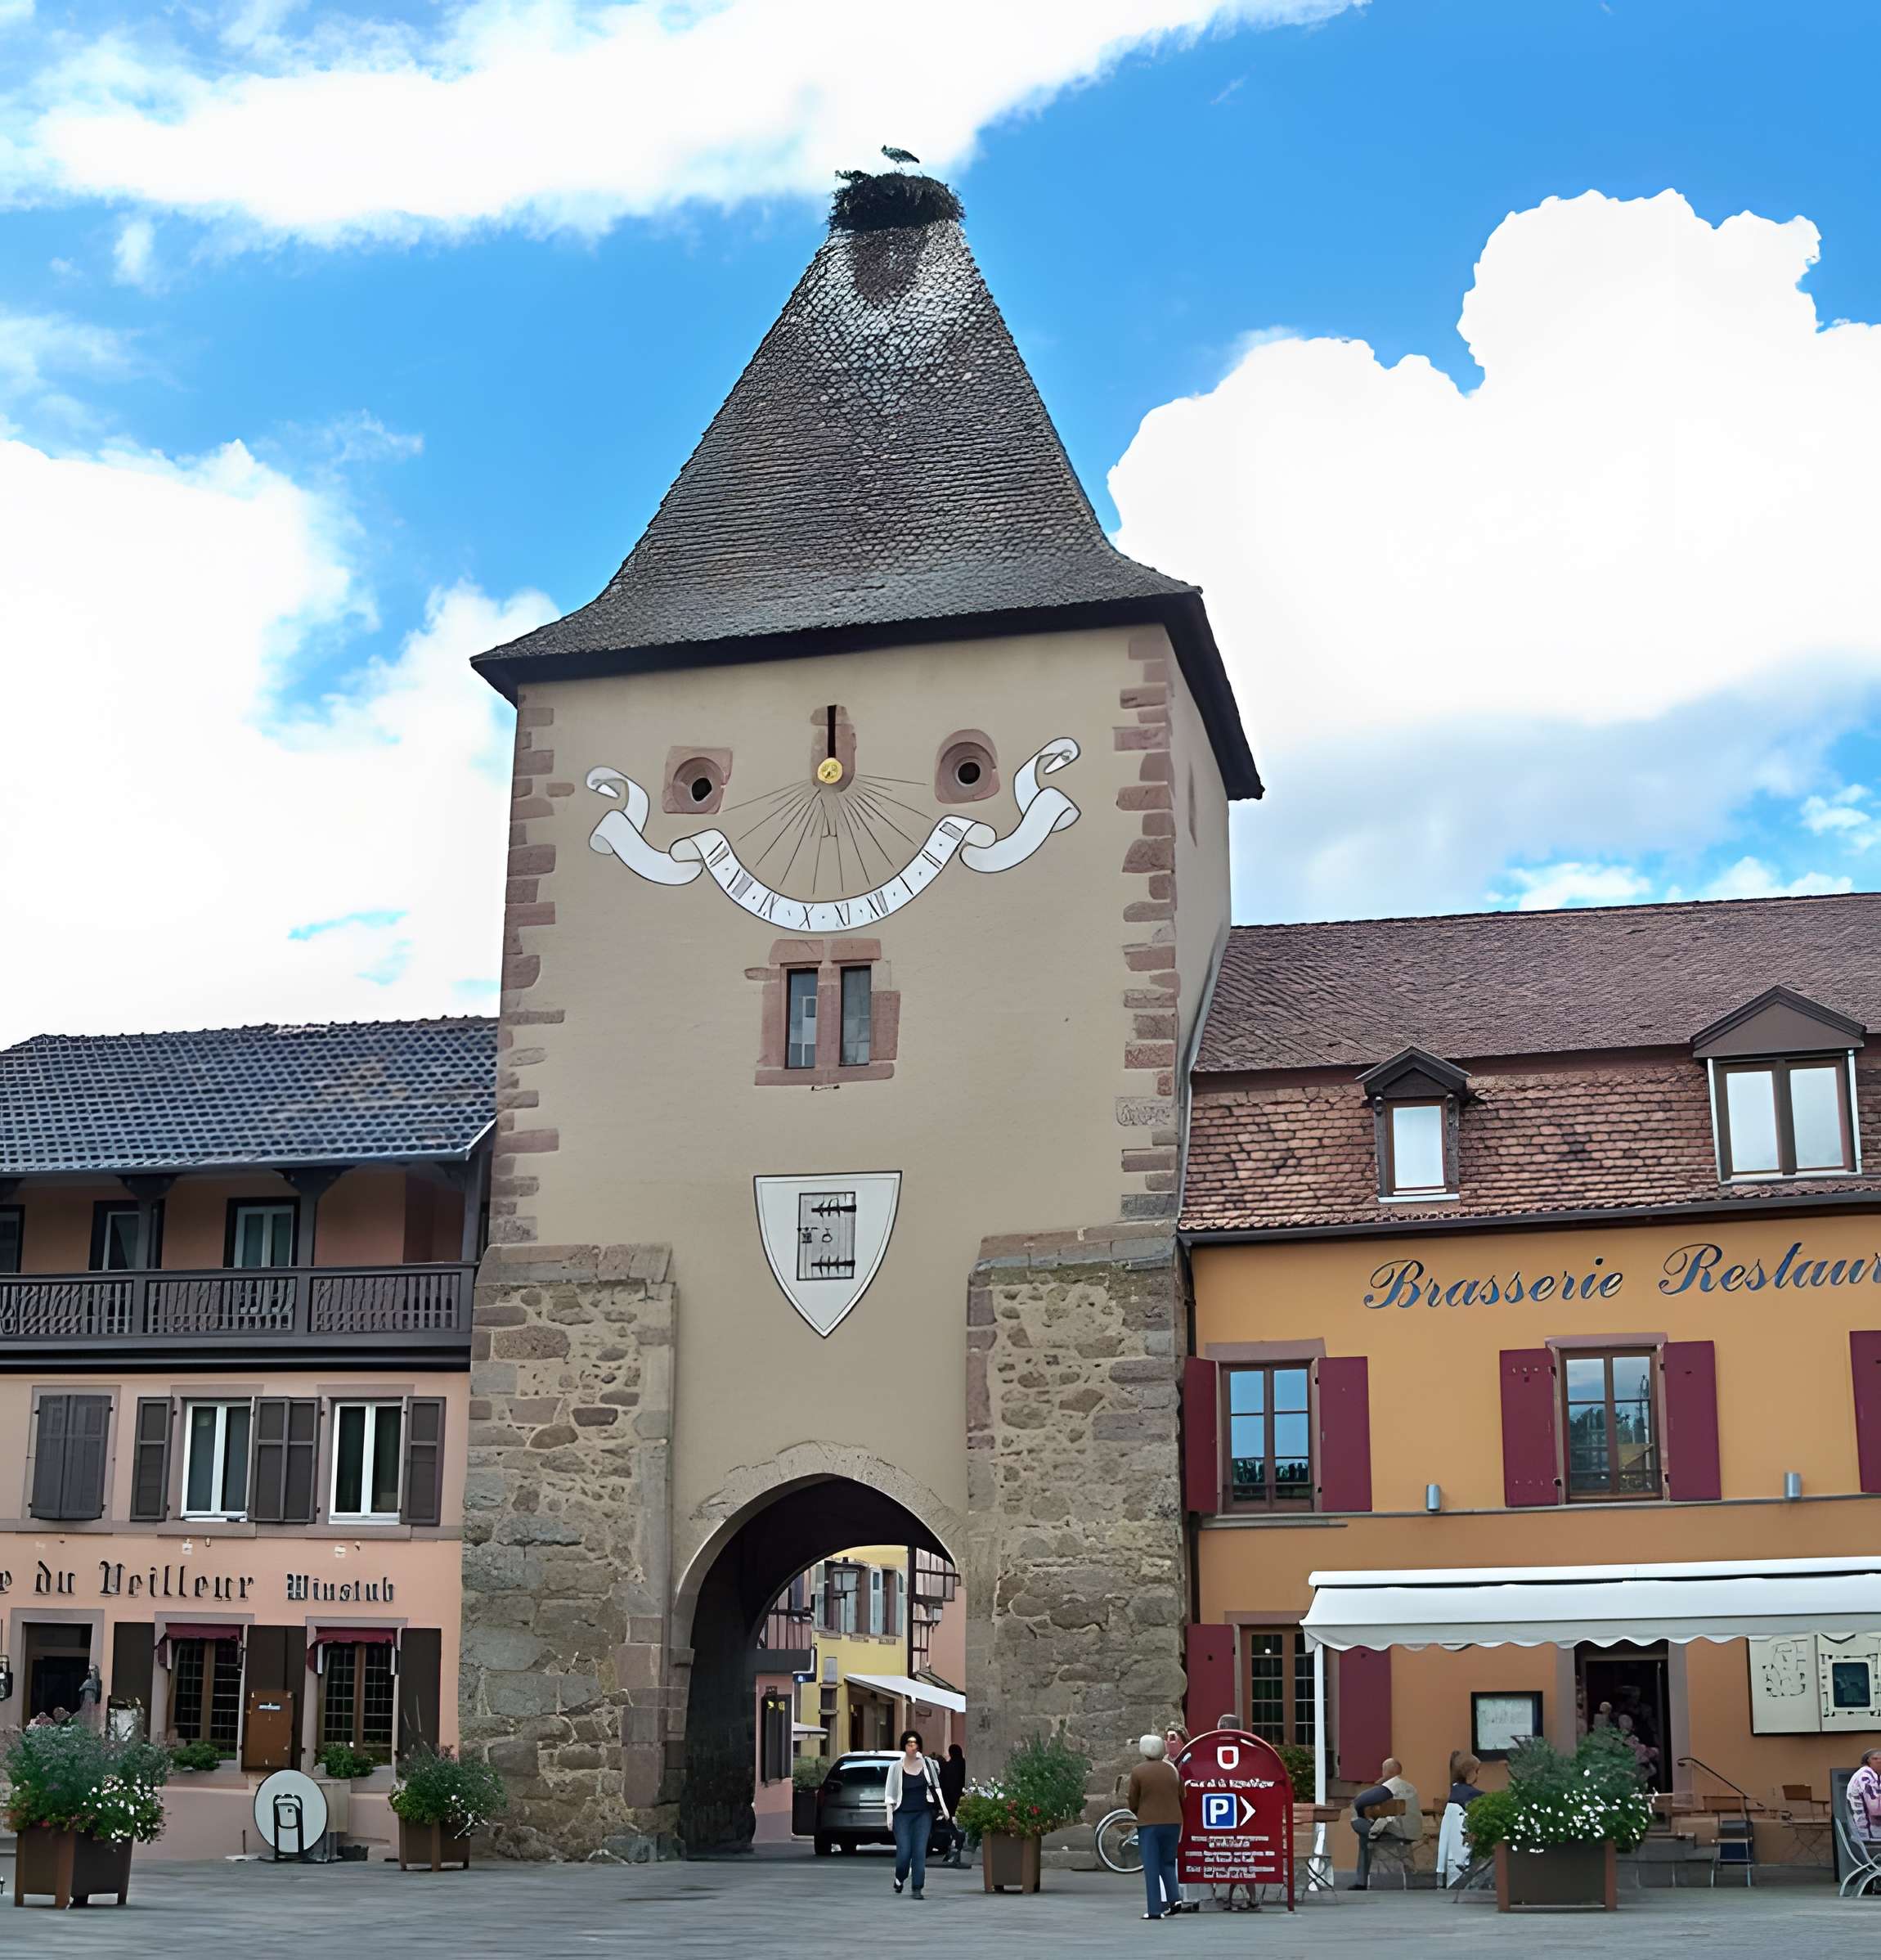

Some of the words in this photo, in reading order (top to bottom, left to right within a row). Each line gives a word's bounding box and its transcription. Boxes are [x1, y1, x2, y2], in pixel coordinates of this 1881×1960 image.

[1363, 1257, 1623, 1309] Brasserie
[33, 1559, 76, 1596] du
[98, 1560, 255, 1601] Veilleur
[1210, 1798, 1229, 1824] P
